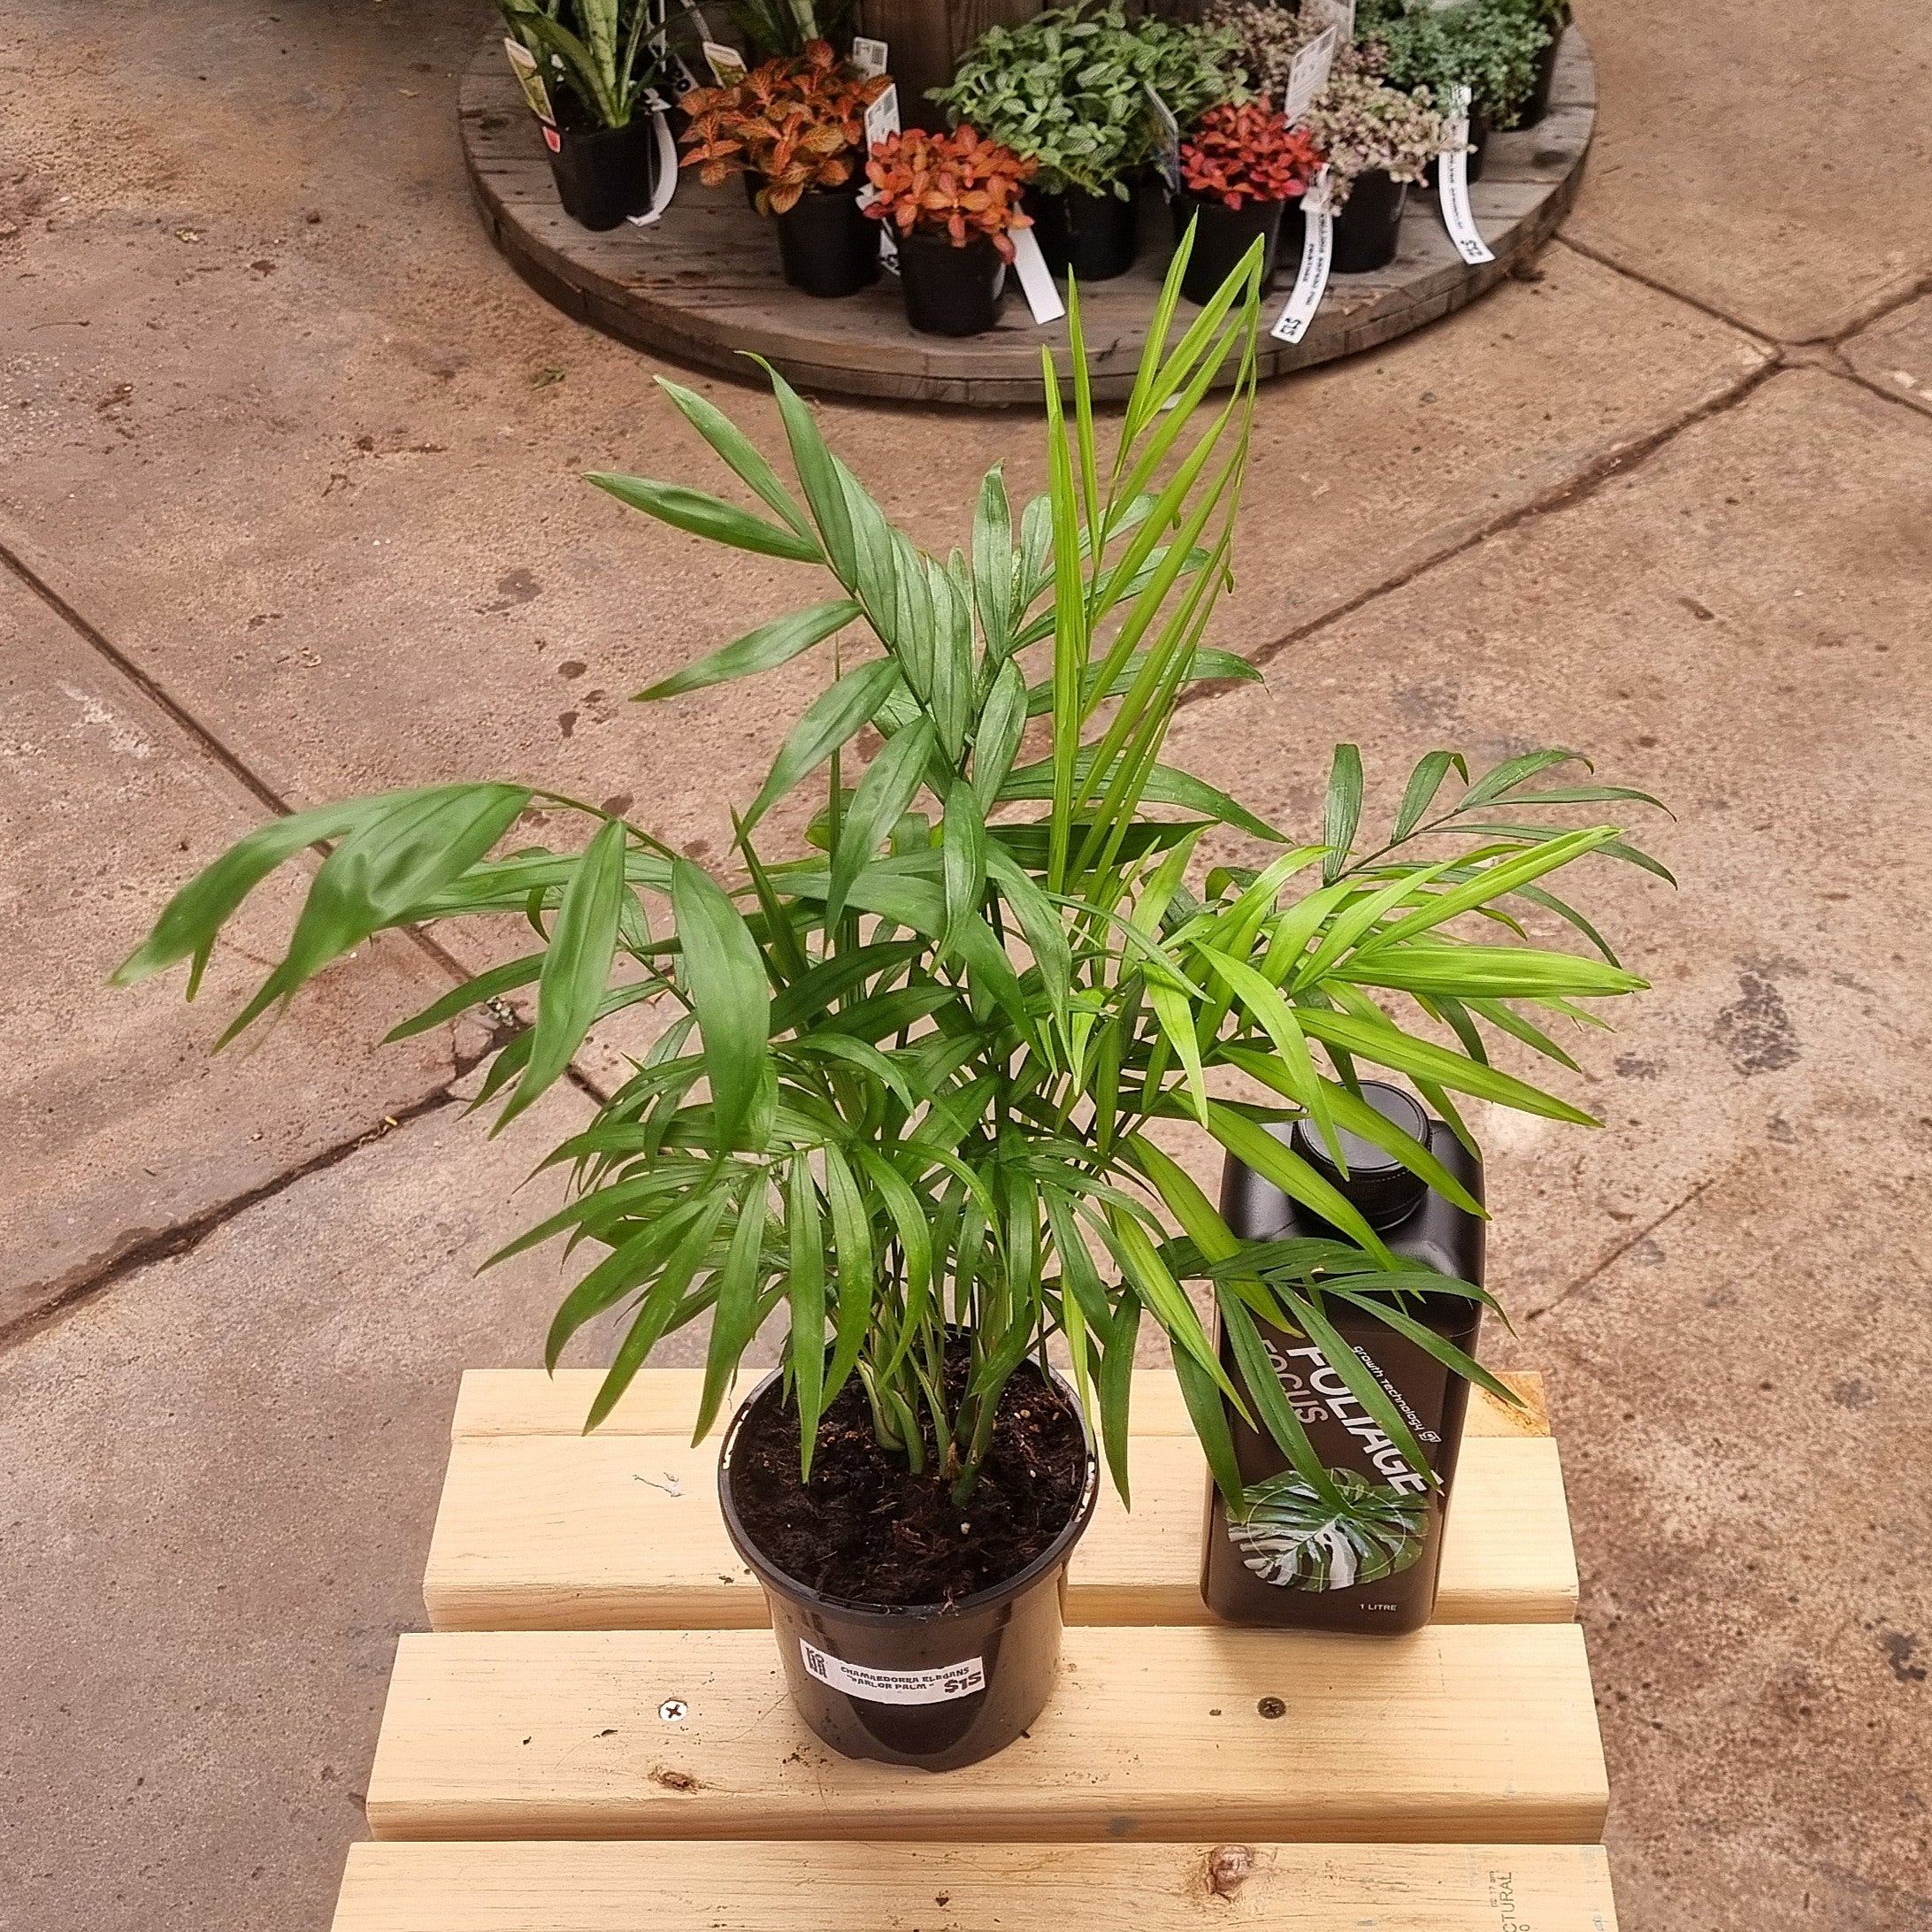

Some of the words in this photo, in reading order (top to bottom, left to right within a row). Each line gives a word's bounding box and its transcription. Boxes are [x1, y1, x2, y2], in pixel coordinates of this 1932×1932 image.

[1353, 1346, 1384, 1378] growth
[1286, 1346, 1444, 1496] FOLIAGE
[944, 1671, 982, 1693] $15
